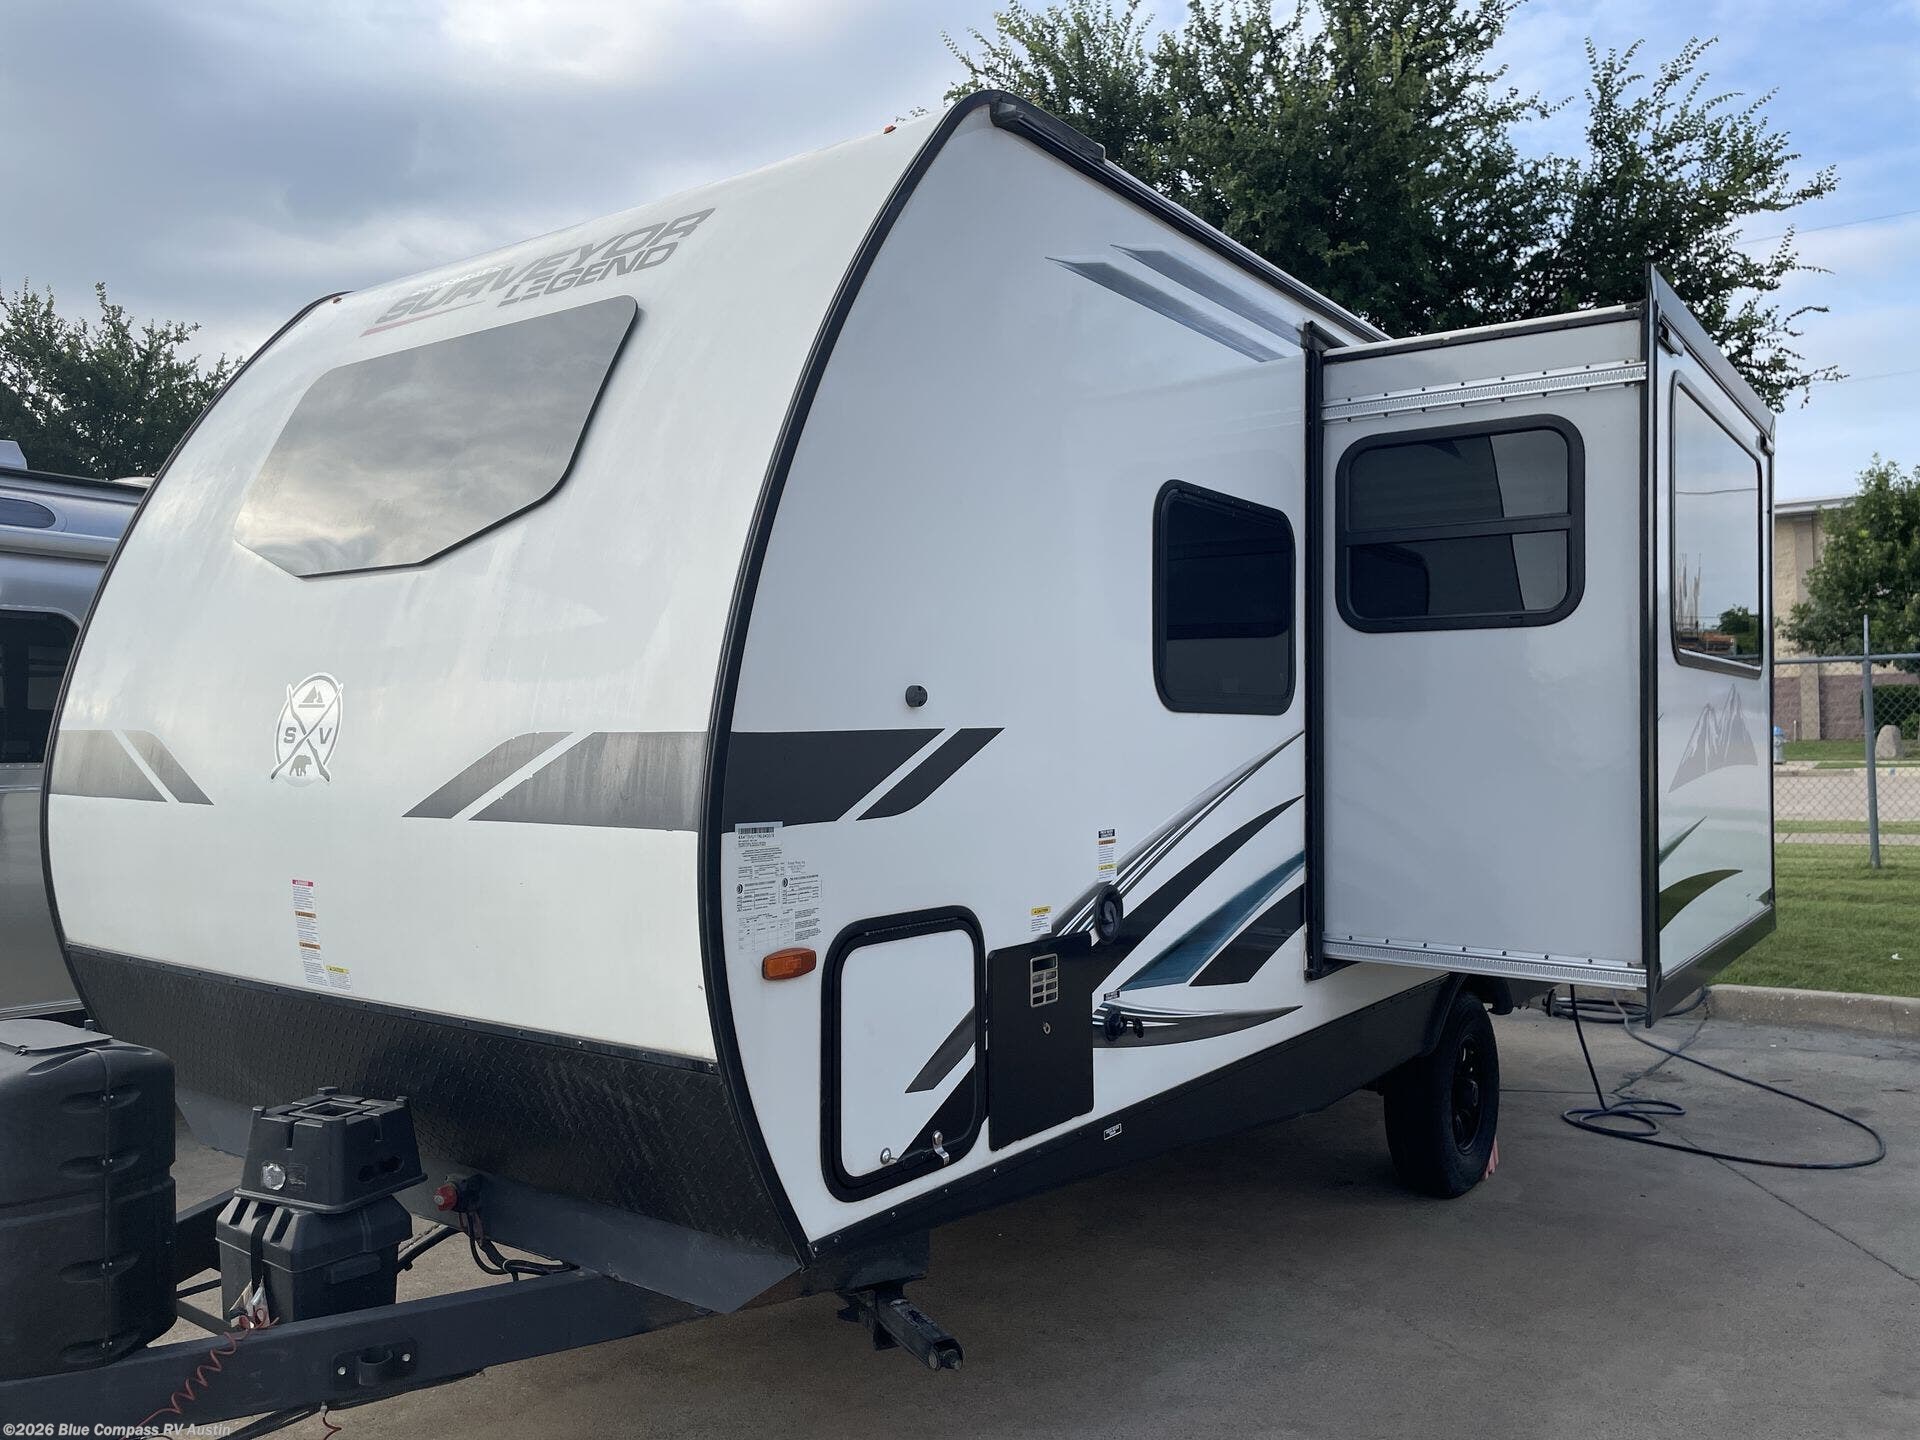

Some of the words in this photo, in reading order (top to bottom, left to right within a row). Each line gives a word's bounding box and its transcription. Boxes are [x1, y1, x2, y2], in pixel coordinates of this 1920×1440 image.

[375, 207, 715, 324] SURVEYOR
[497, 241, 679, 308] LEGEND
[283, 727, 296, 743] S
[319, 727, 332, 744] V
